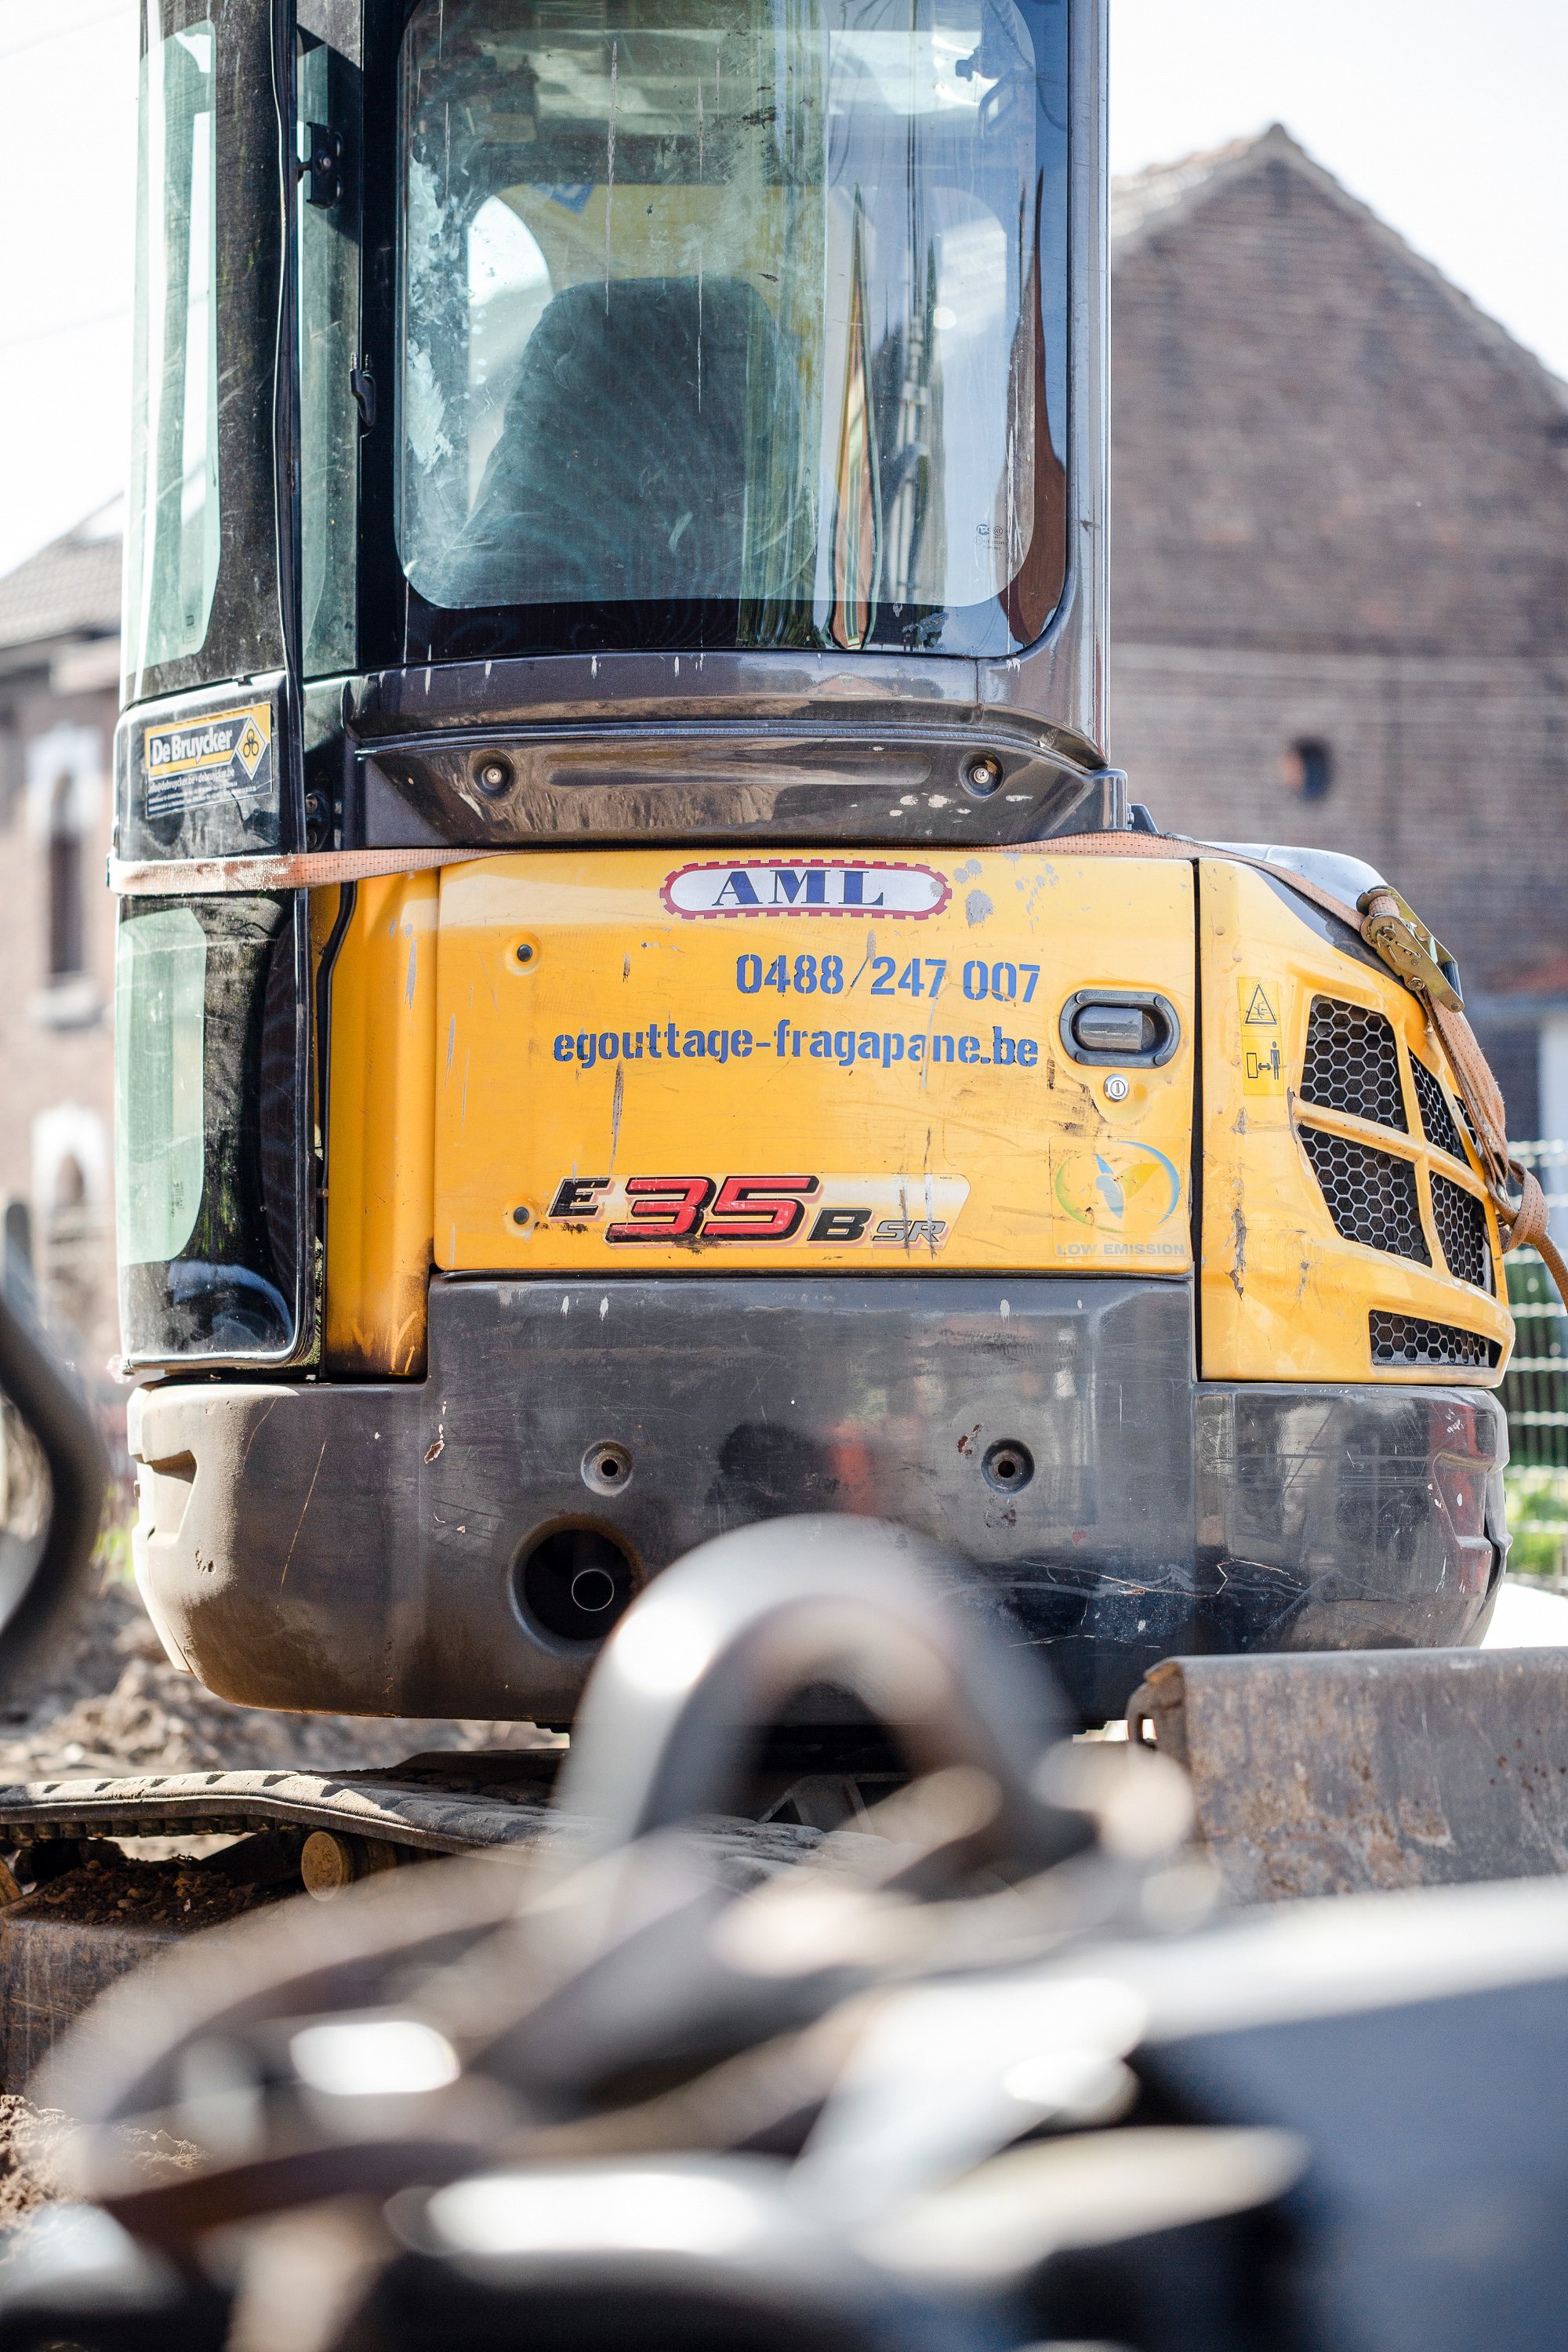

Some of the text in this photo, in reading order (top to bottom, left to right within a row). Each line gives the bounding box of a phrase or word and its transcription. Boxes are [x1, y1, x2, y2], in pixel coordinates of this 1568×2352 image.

[151, 727, 233, 765] De Bruycker
[711, 869, 884, 906] AML
[963, 960, 1040, 1003] 007
[554, 1019, 1038, 1069] egouttage-fragapane.be
[1057, 1243, 1185, 1255] LOW EMISSION
